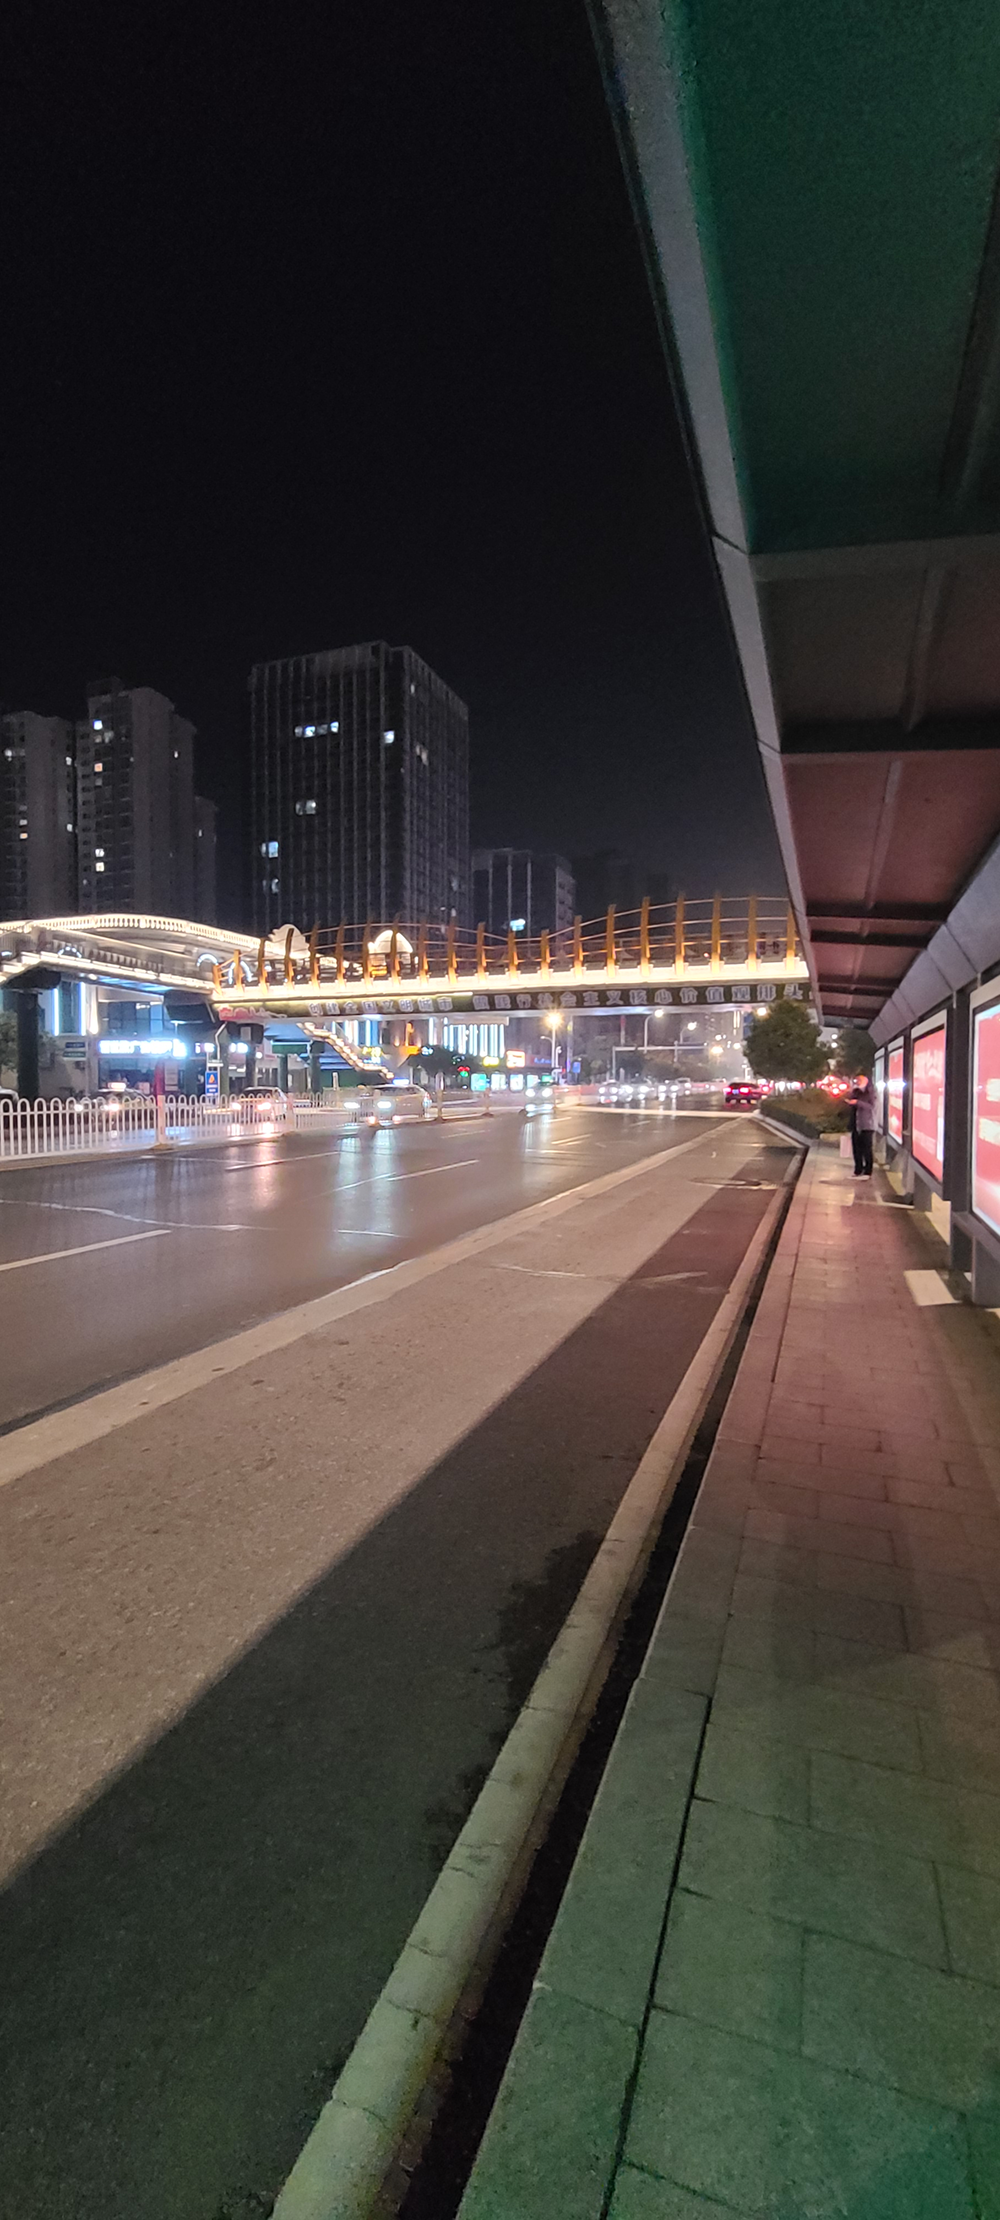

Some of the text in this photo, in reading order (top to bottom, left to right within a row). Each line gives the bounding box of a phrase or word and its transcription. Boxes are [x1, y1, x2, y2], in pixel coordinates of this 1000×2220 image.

[308, 996, 453, 1016] 创建全国文明城市
